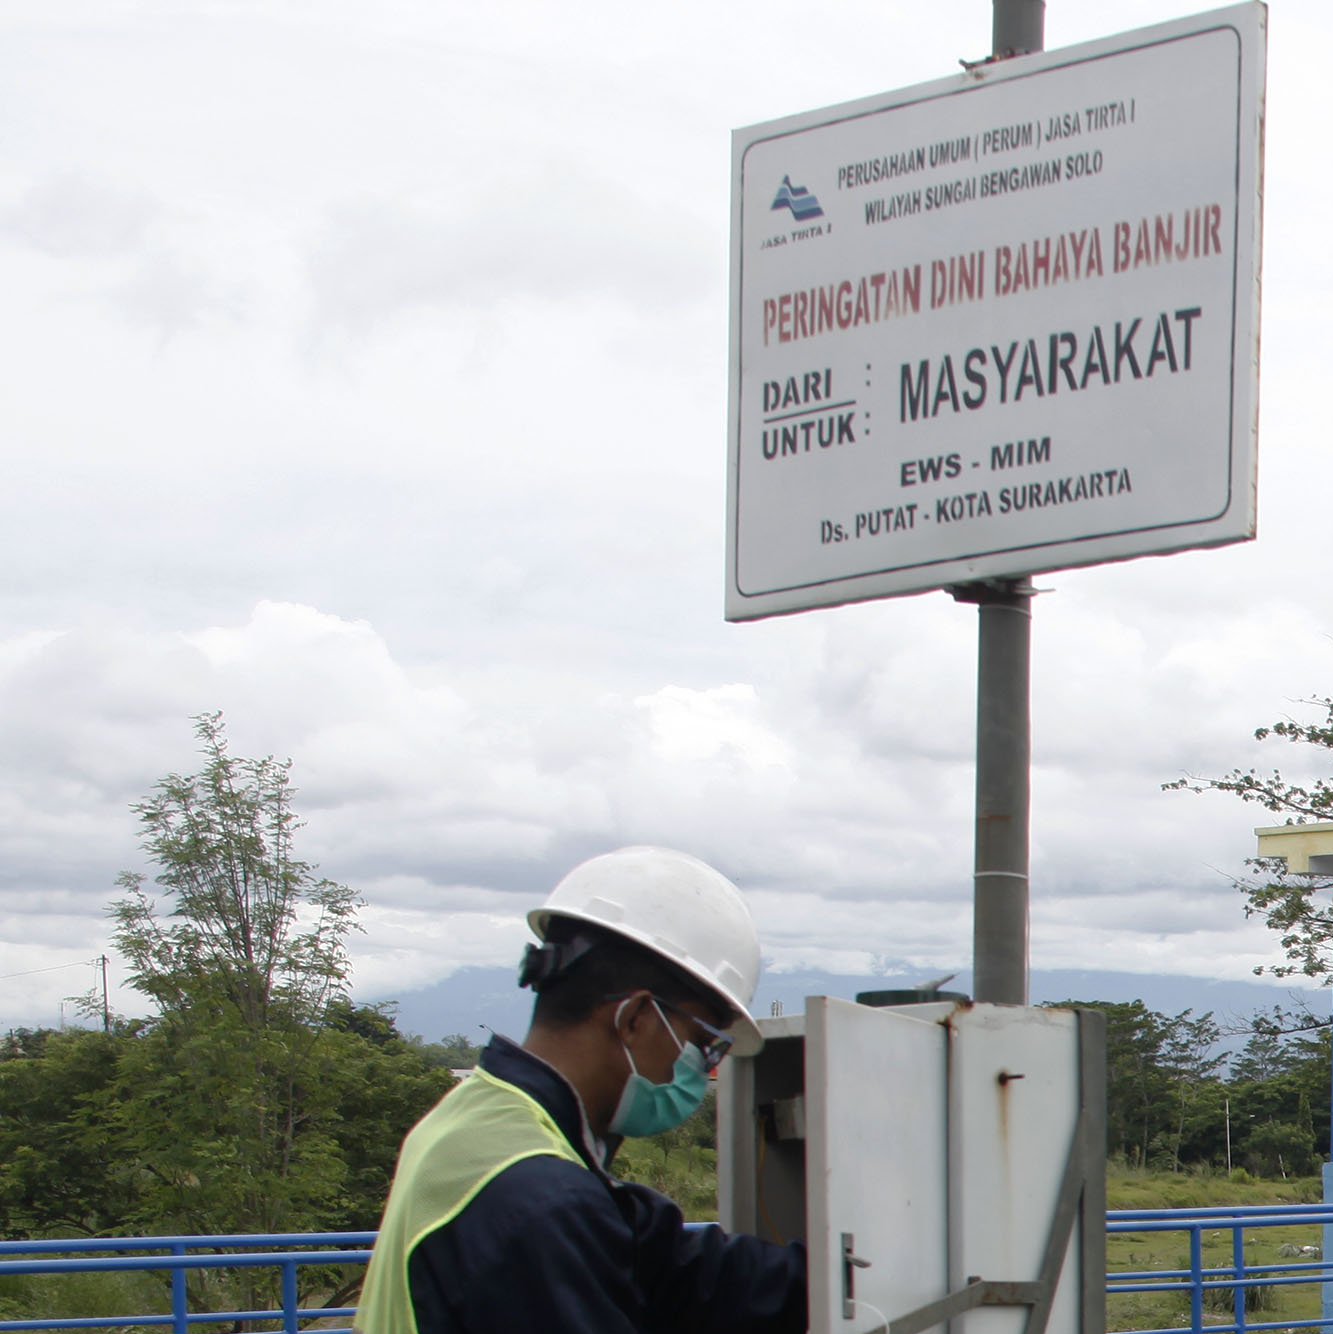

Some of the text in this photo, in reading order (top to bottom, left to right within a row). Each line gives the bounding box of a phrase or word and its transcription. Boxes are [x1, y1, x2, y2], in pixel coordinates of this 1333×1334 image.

[837, 146, 926, 190] PERUSAHAAN
[929, 136, 971, 169] UMUM
[1045, 114, 1081, 143] JASA
[1085, 102, 1127, 132] TIRTA
[1130, 98, 1136, 123] I
[864, 150, 1103, 225] WILAYAH SUNGAI BENGAWAN SOLO
[760, 235, 787, 250] JASA
[763, 204, 1223, 347] PERINGATAN DINI BAHAYA BANJIR
[762, 368, 832, 413] DARI
[900, 306, 1202, 424] MASYARAKAT
[761, 412, 856, 460] UNTUK
[900, 453, 962, 487] EWS
[990, 437, 1051, 471] MIM
[820, 519, 849, 544] Ds.
[855, 504, 918, 538] PUTAT
[936, 490, 993, 524] KOTA
[998, 468, 1132, 513] SURAKARTA
